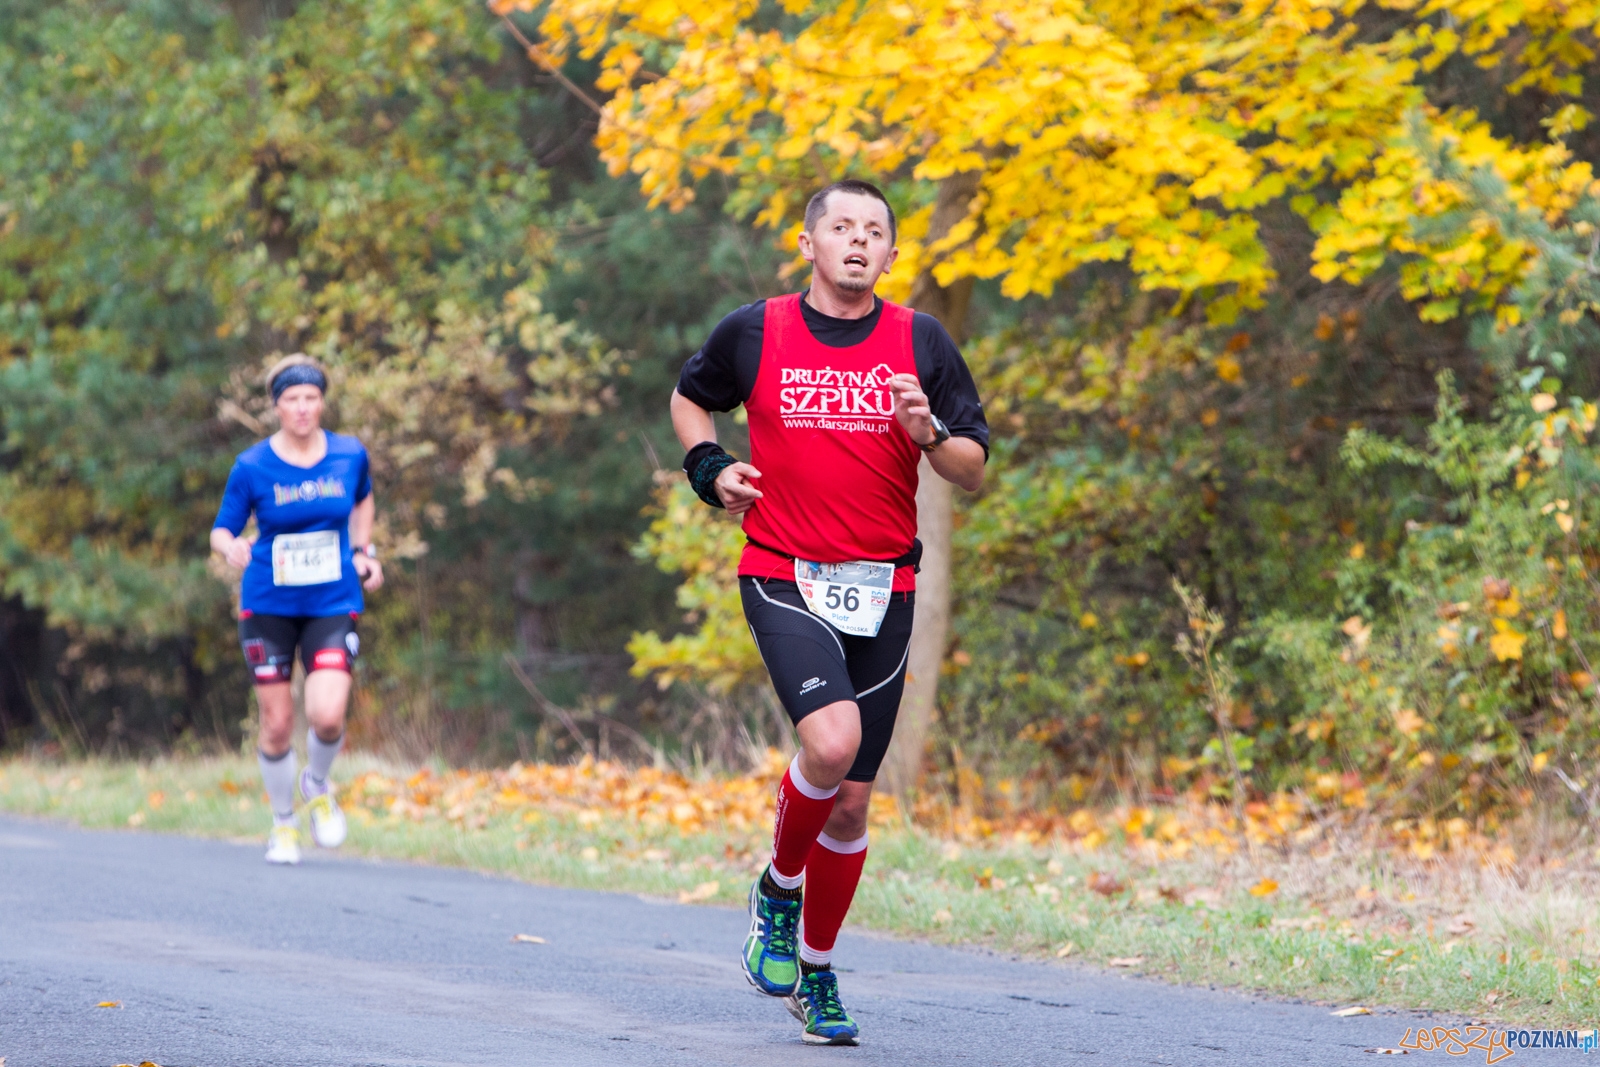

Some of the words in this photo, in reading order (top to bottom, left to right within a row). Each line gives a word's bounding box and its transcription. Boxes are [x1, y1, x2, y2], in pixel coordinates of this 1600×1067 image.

[780, 366, 878, 388] DRUŻYNA
[780, 387, 895, 416] SZPIKU
[783, 418, 890, 434] www.darszpiku.pl
[825, 584, 860, 612] 56
[832, 612, 850, 622] Piotr
[846, 625, 869, 633] POLSKA
